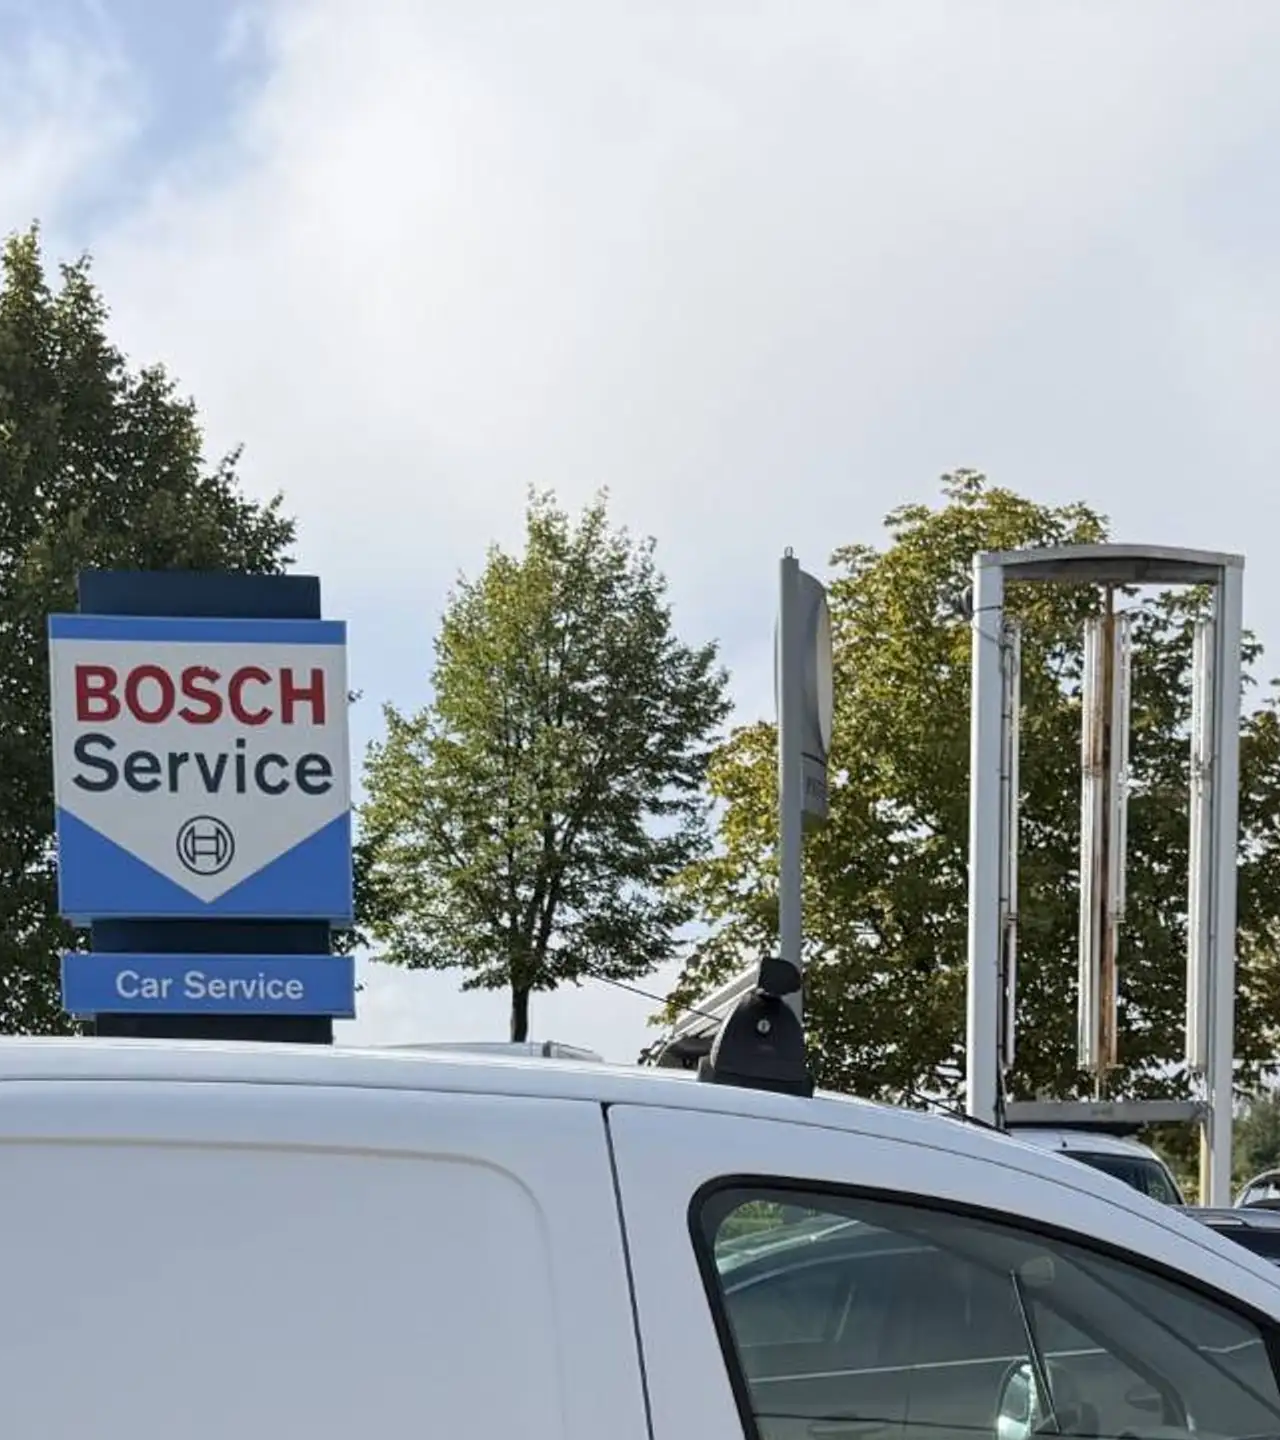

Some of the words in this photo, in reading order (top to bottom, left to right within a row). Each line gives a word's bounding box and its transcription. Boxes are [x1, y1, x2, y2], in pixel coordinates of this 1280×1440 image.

[74, 665, 326, 725] BOSCH
[72, 732, 333, 796] Service
[116, 970, 173, 999] Car
[184, 971, 304, 1001] Service
